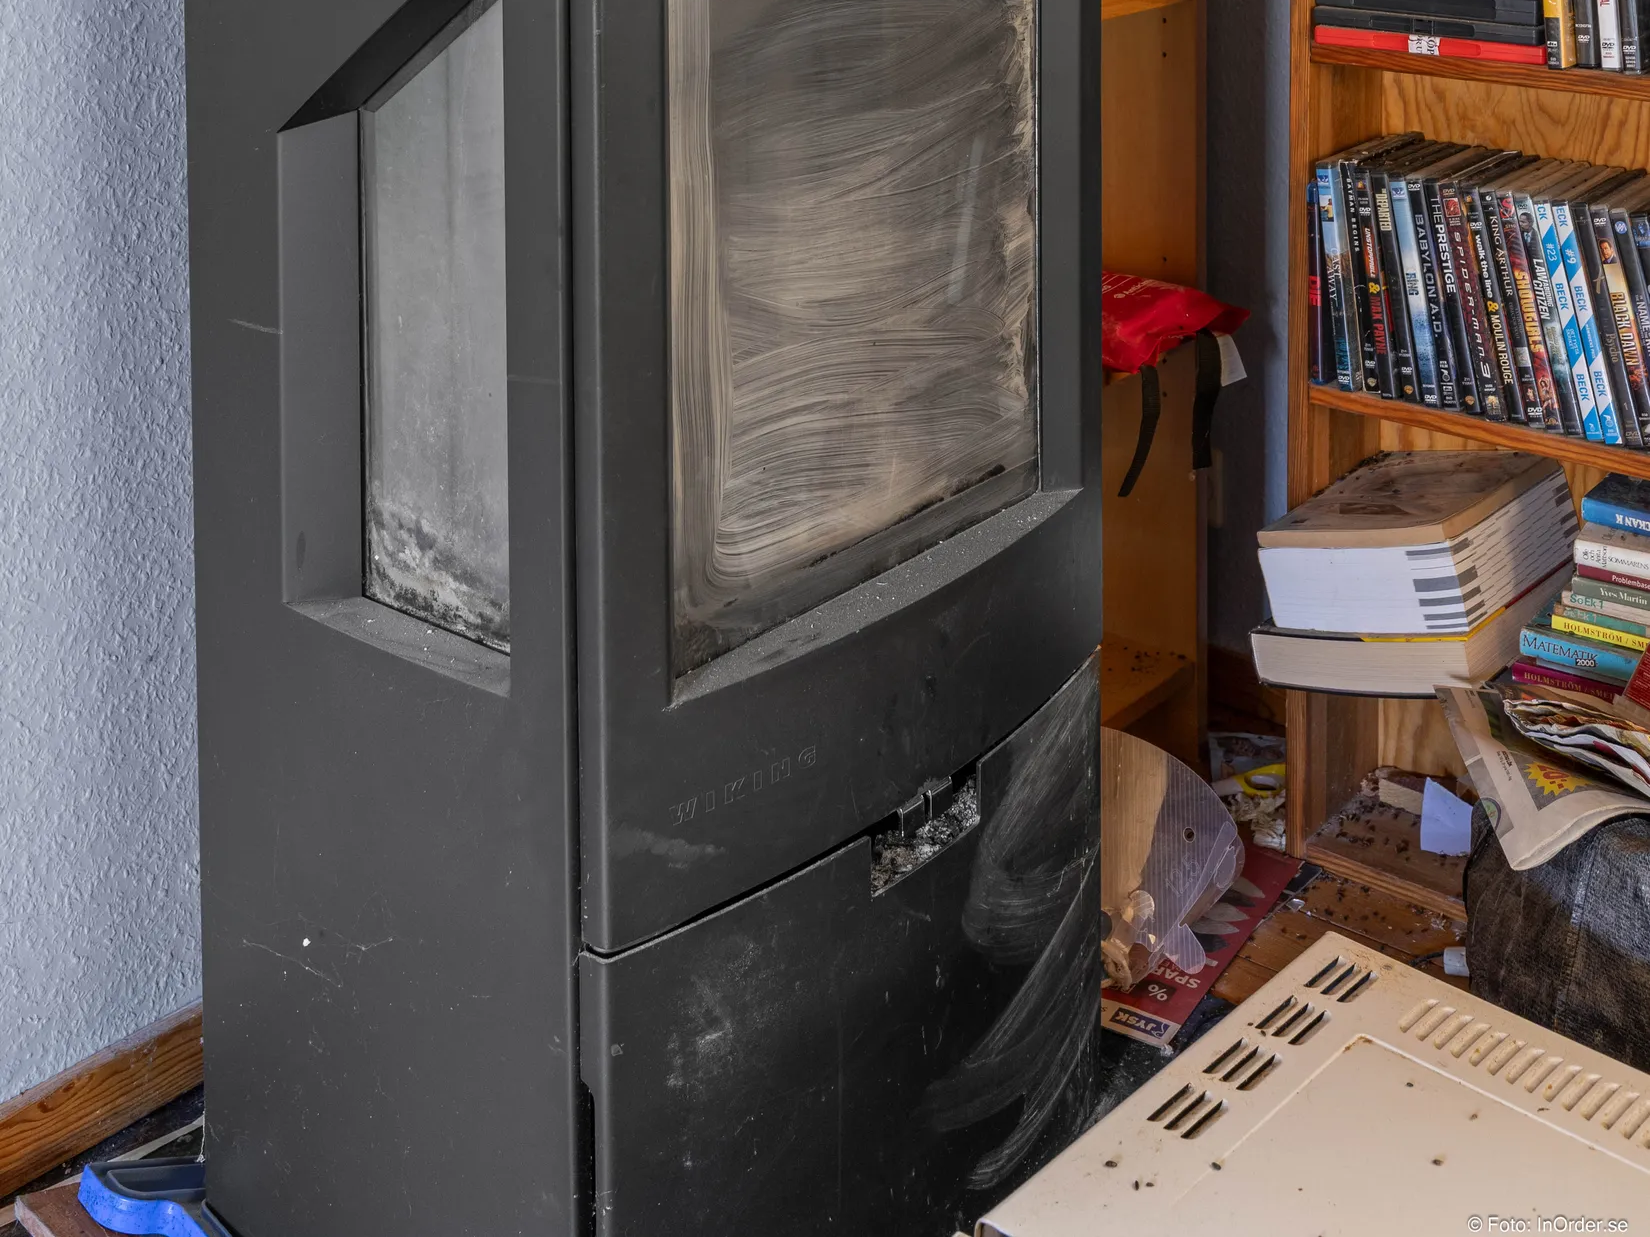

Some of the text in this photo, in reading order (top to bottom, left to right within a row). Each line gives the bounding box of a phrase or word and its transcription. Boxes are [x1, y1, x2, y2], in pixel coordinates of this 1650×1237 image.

[1346, 178, 1360, 252] BATMAN BEGINS
[1375, 193, 1392, 231] DEPARTED
[1431, 196, 1456, 293] THE PRESTIGE
[1490, 216, 1514, 297] KING ARTHUR
[1309, 275, 1321, 307] DIE
[1327, 266, 1338, 301] AWAY
[1368, 281, 1380, 294] &
[1415, 214, 1443, 338] BABYLON A.D.
[1546, 243, 1569, 310] #23 BECK
[1564, 248, 1577, 264] #9
[1574, 285, 1588, 311] BECK
[1370, 296, 1383, 320] MAX
[1475, 234, 1514, 385] walk the line & MOULIN ROUGE
[1514, 270, 1545, 353] SHOWGIRLS
[1533, 282, 1550, 320] CITIZEN
[1636, 301, 1650, 332] NAME
[1373, 323, 1387, 355] PAYNE
[1610, 292, 1640, 366] BLACK DAWN
[1605, 333, 1619, 363] Psycho
[1576, 373, 1590, 401] BECK
[1594, 371, 1608, 397] BECK
[1607, 555, 1650, 570] SOMMARENS
[1600, 587, 1648, 605] Yves Martin
[1563, 622, 1623, 643] HOLMSTRÖM
[1522, 634, 1598, 667] MATEMATIK 2000
[1524, 672, 1582, 692] HOLMSTRÖM
[668, 745, 816, 826] WIKING
[1116, 1011, 1157, 1031] JYSK
